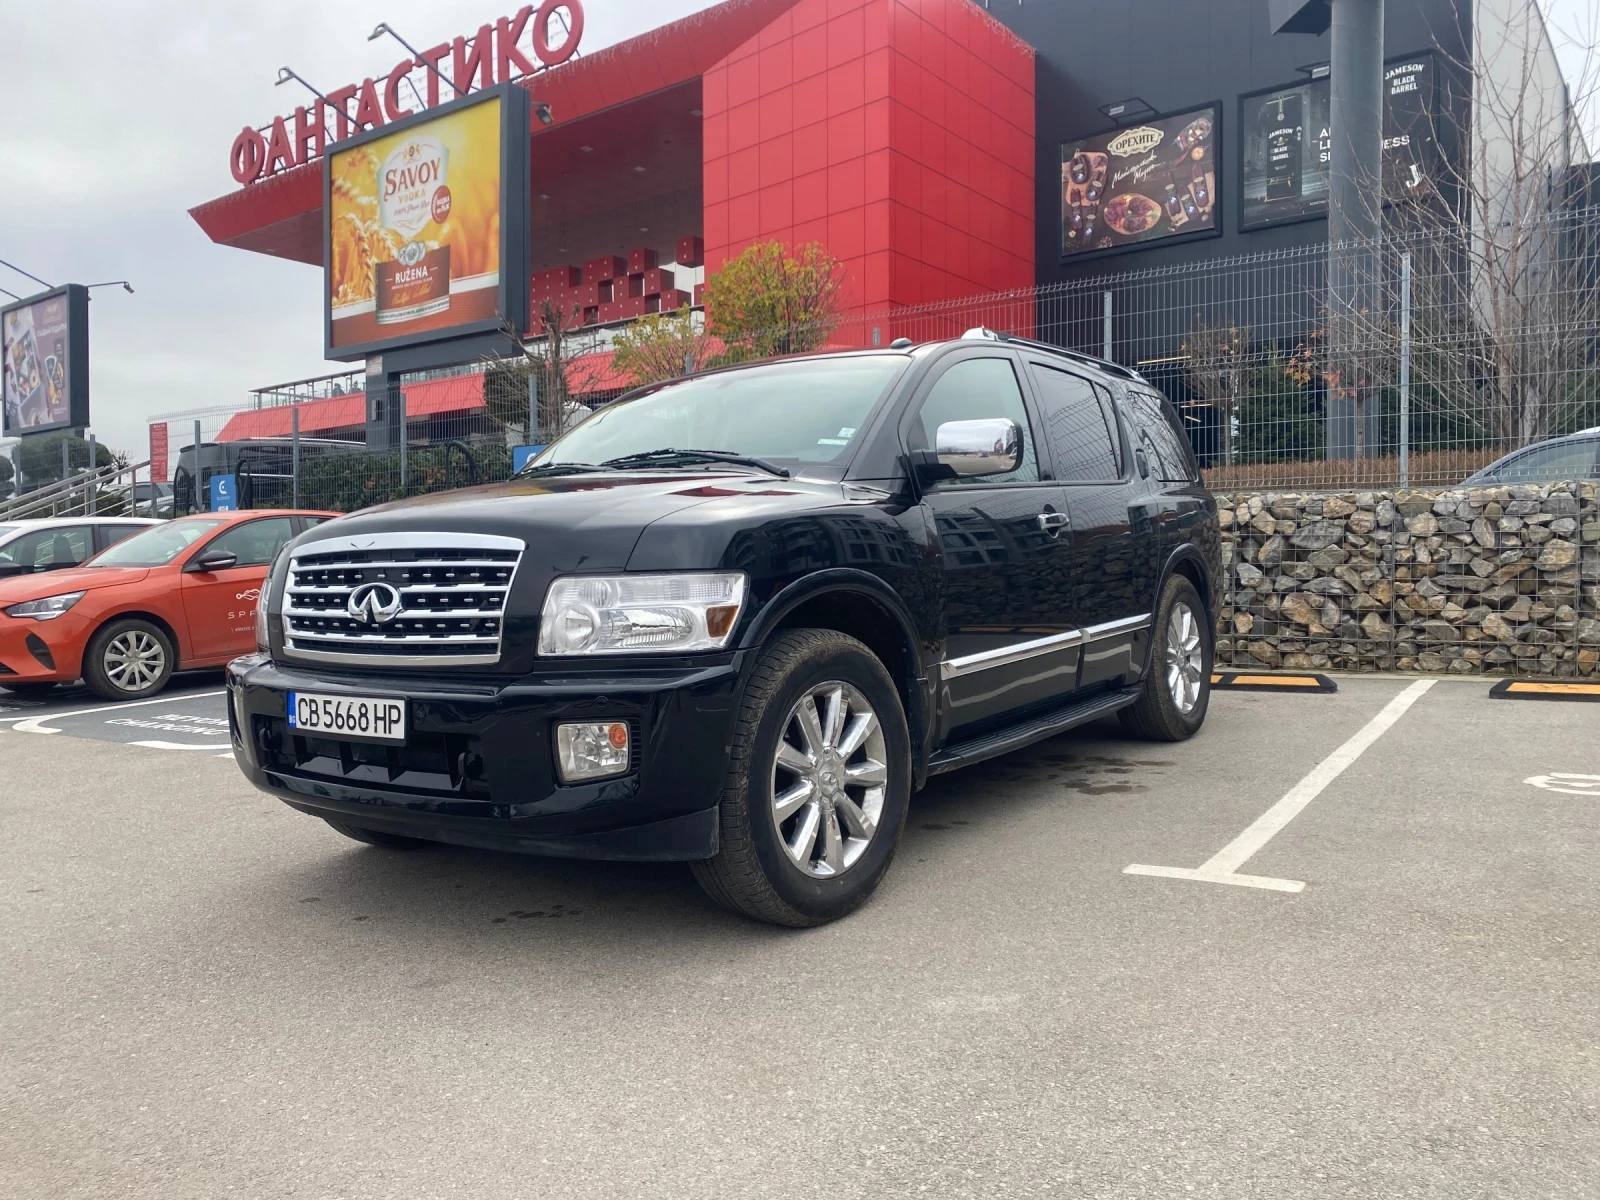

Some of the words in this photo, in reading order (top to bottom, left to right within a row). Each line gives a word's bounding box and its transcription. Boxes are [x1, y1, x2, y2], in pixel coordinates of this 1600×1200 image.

[1385, 63, 1425, 80] JAMESON
[1391, 82, 1418, 95] BARREL
[1393, 75, 1416, 86] BLACK
[230, 0, 584, 186] ФАНТАСТИКО
[1268, 128, 1293, 139] JAMESON
[1115, 134, 1156, 150] ОРЕХИТЕ
[1273, 153, 1289, 161] BARREL
[383, 157, 441, 202] SAVOY
[398, 188, 426, 204] VODKA
[395, 265, 428, 284] RUŽENA
